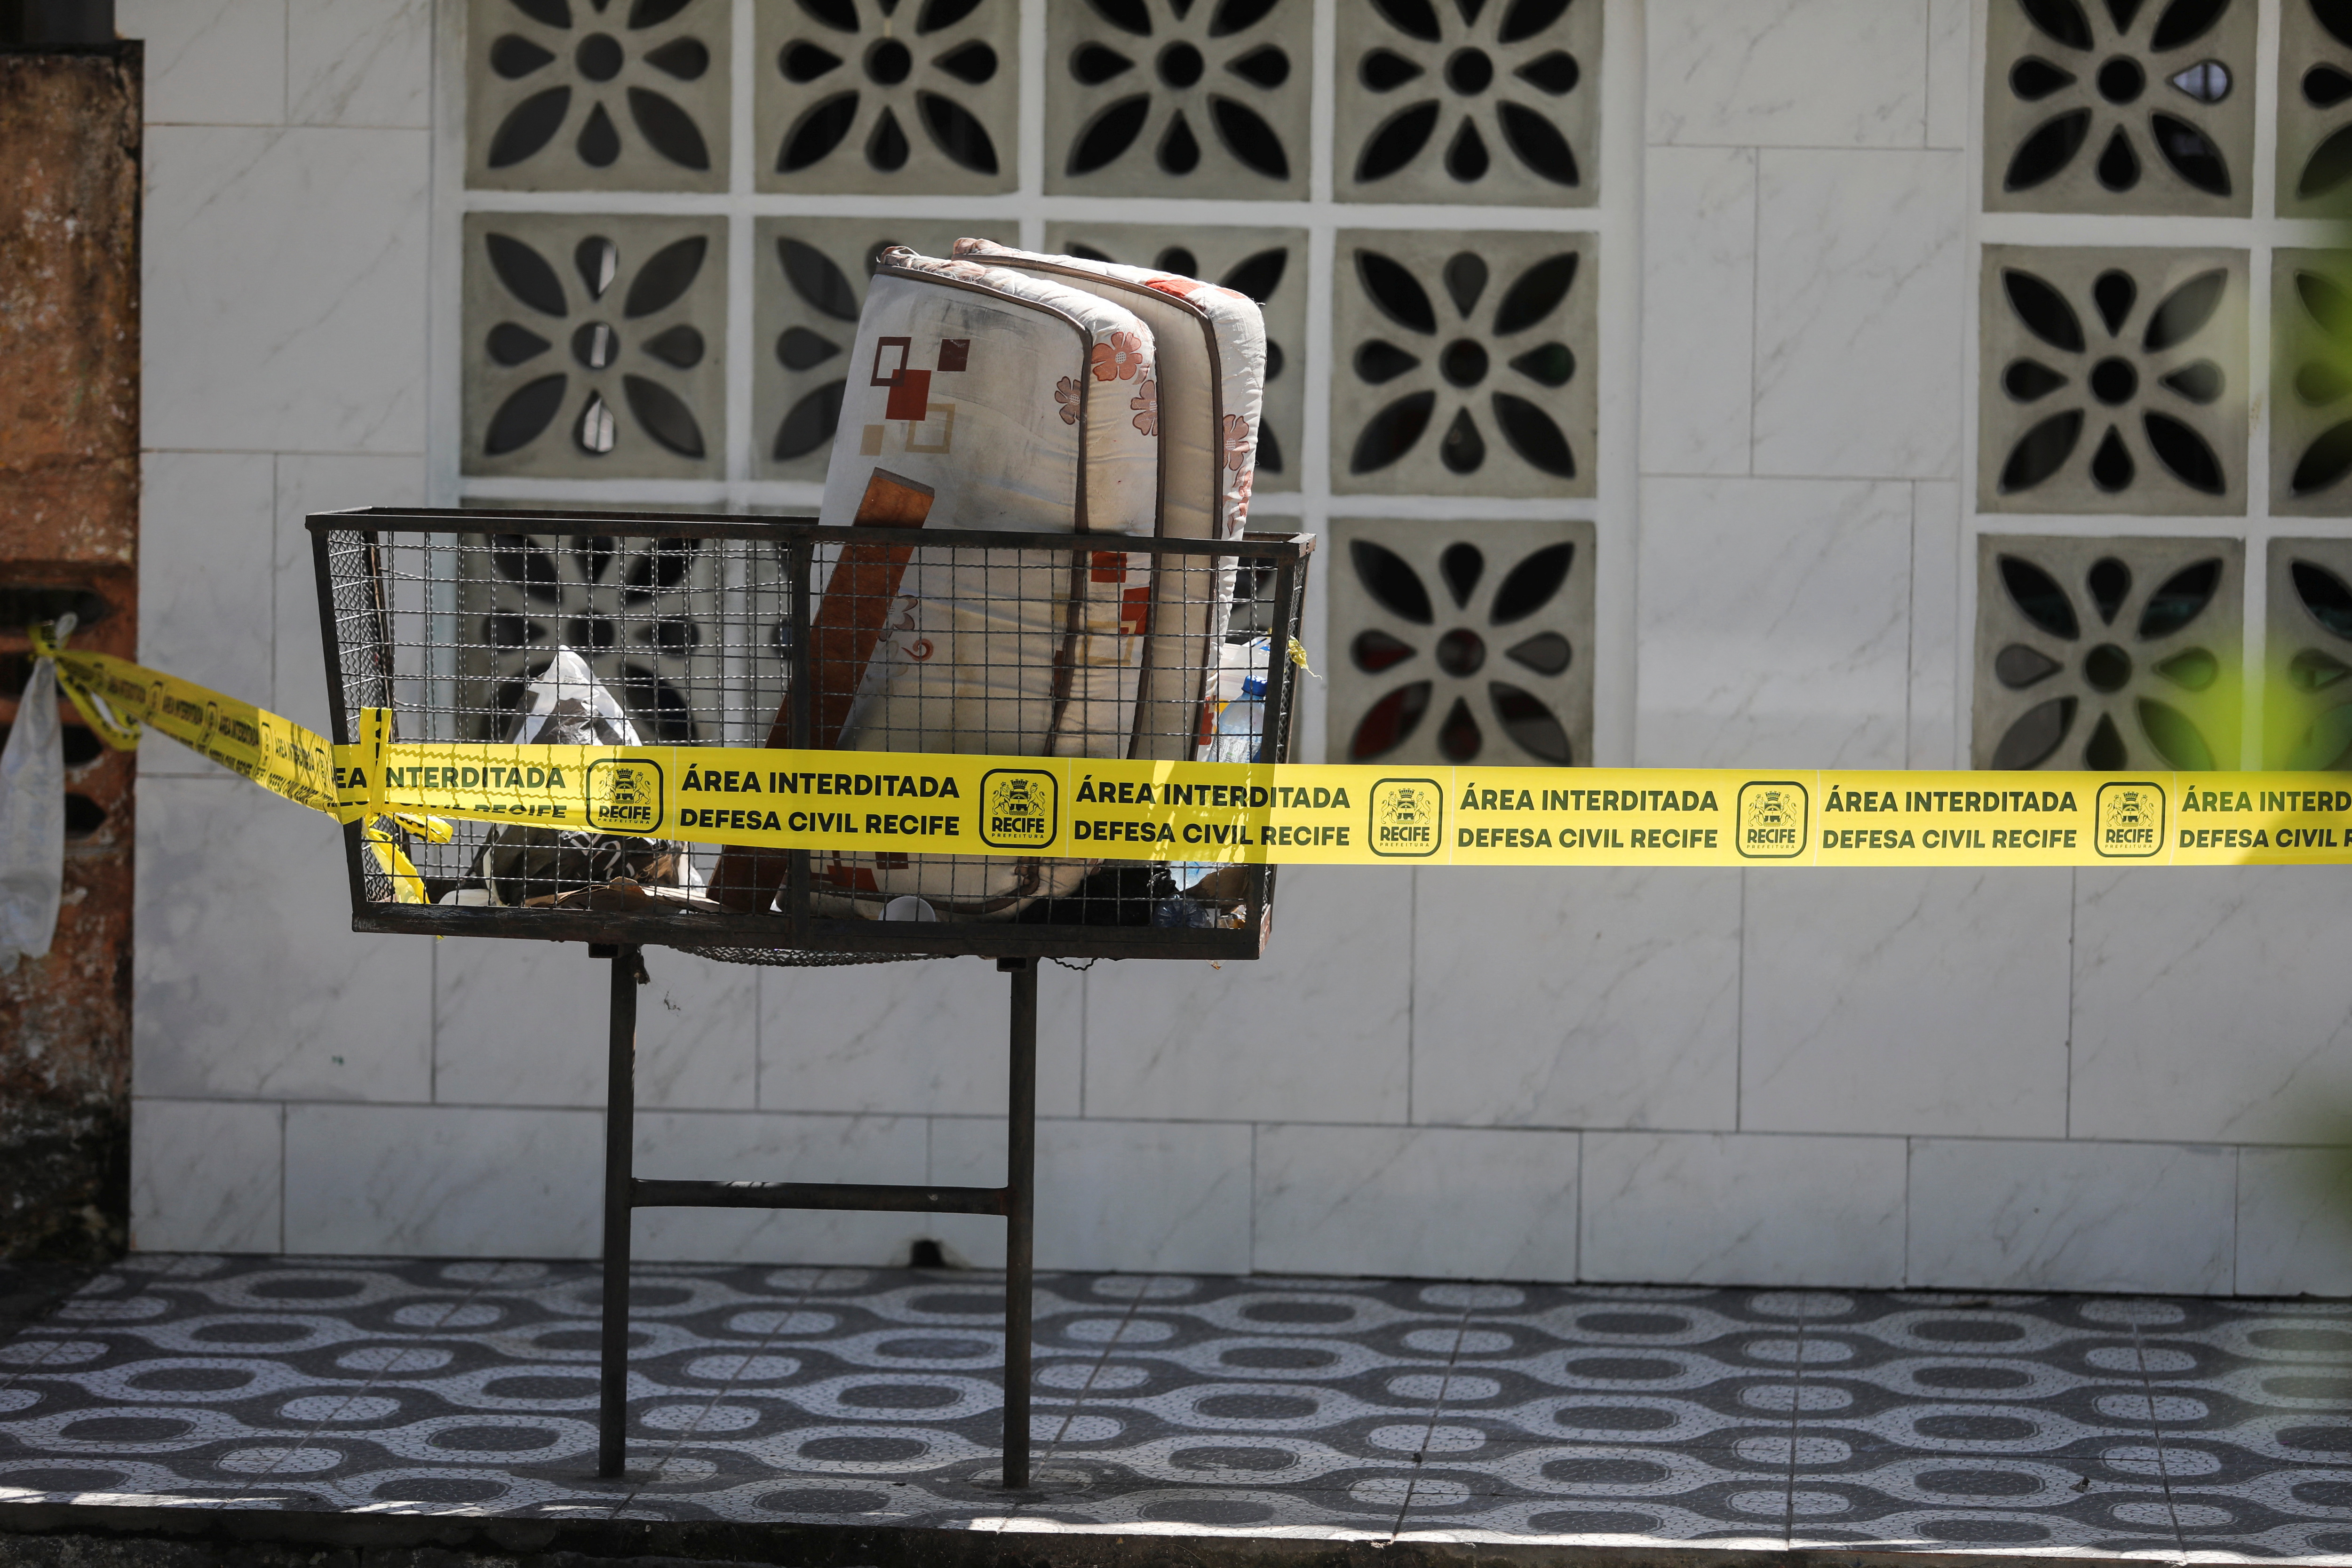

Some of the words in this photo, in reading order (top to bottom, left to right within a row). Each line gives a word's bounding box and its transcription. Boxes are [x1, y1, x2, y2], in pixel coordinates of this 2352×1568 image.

[336, 767, 367, 788] EA
[386, 767, 565, 788] NTERDITADA
[682, 764, 761, 792] ÁREA
[770, 772, 960, 798] INTERDITADA
[1076, 775, 1155, 804] ÁREA
[1164, 784, 1350, 808] INTERDITADA
[1460, 783, 1534, 810] ÁREA
[1542, 790, 1718, 811] INTERDITADA
[1825, 785, 1898, 812] ÁREA
[1906, 792, 2077, 811] INTERDITADA
[2182, 785, 2252, 811] ÁREA
[599, 806, 651, 820] RECIFE
[681, 809, 781, 830] DEFESA
[789, 812, 858, 833] CIVIL
[866, 814, 959, 836] RECIFE
[992, 817, 1044, 833] RECIFE
[1075, 820, 1175, 842] DEFESA
[1183, 824, 1253, 844] CIVIL
[1261, 826, 1349, 845] RECIFE
[1381, 827, 1430, 841] RECIFE
[1458, 828, 1552, 847] DEFESA
[1559, 829, 1623, 847] CIVIL
[1631, 829, 1717, 848] RECIFE
[1748, 829, 1795, 843] RECIFE
[1823, 830, 1915, 848] DEFESA
[1923, 830, 1985, 848] CIVIL
[1993, 830, 2076, 848] RECIFE
[2106, 829, 2153, 843] RECIFE
[2180, 829, 2269, 847] DEFESA
[2276, 829, 2337, 847] CIVIL
